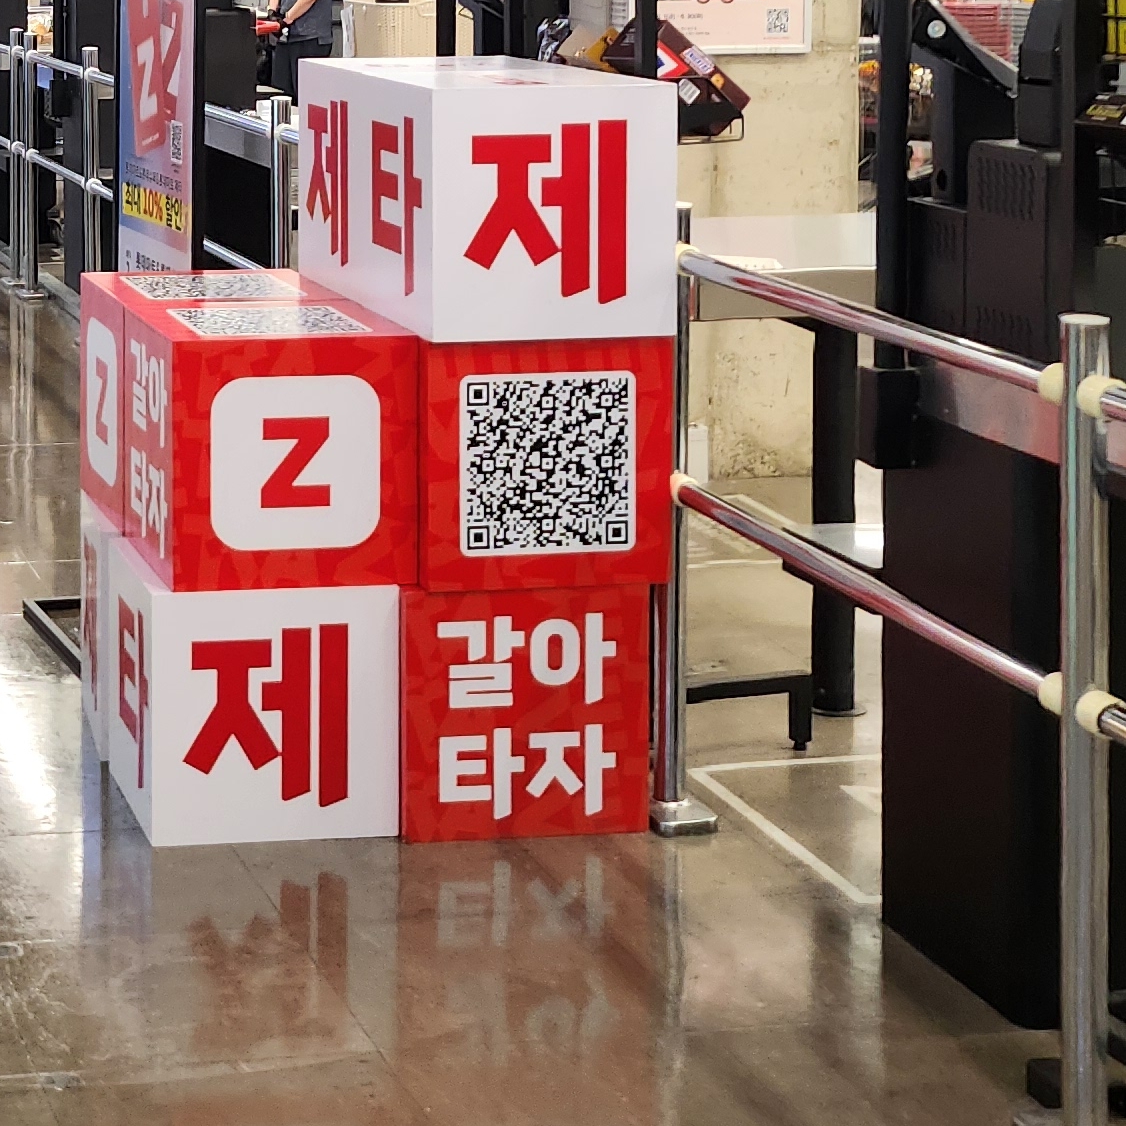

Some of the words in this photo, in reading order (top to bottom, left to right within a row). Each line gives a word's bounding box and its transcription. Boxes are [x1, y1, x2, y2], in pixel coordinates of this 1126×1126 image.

[126, 180, 141, 215] 최대
[143, 186, 163, 222] 10%
[166, 194, 183, 232] 할인
[307, 101, 349, 266] 제
[372, 117, 422, 295] 타
[463, 119, 628, 305] 제
[130, 337, 168, 449] 갈아
[130, 446, 168, 560] 타자
[260, 416, 332, 509] Z
[118, 593, 149, 789] 타
[182, 623, 350, 807] 제
[437, 612, 617, 709] 갈아
[438, 723, 617, 820] 타자
